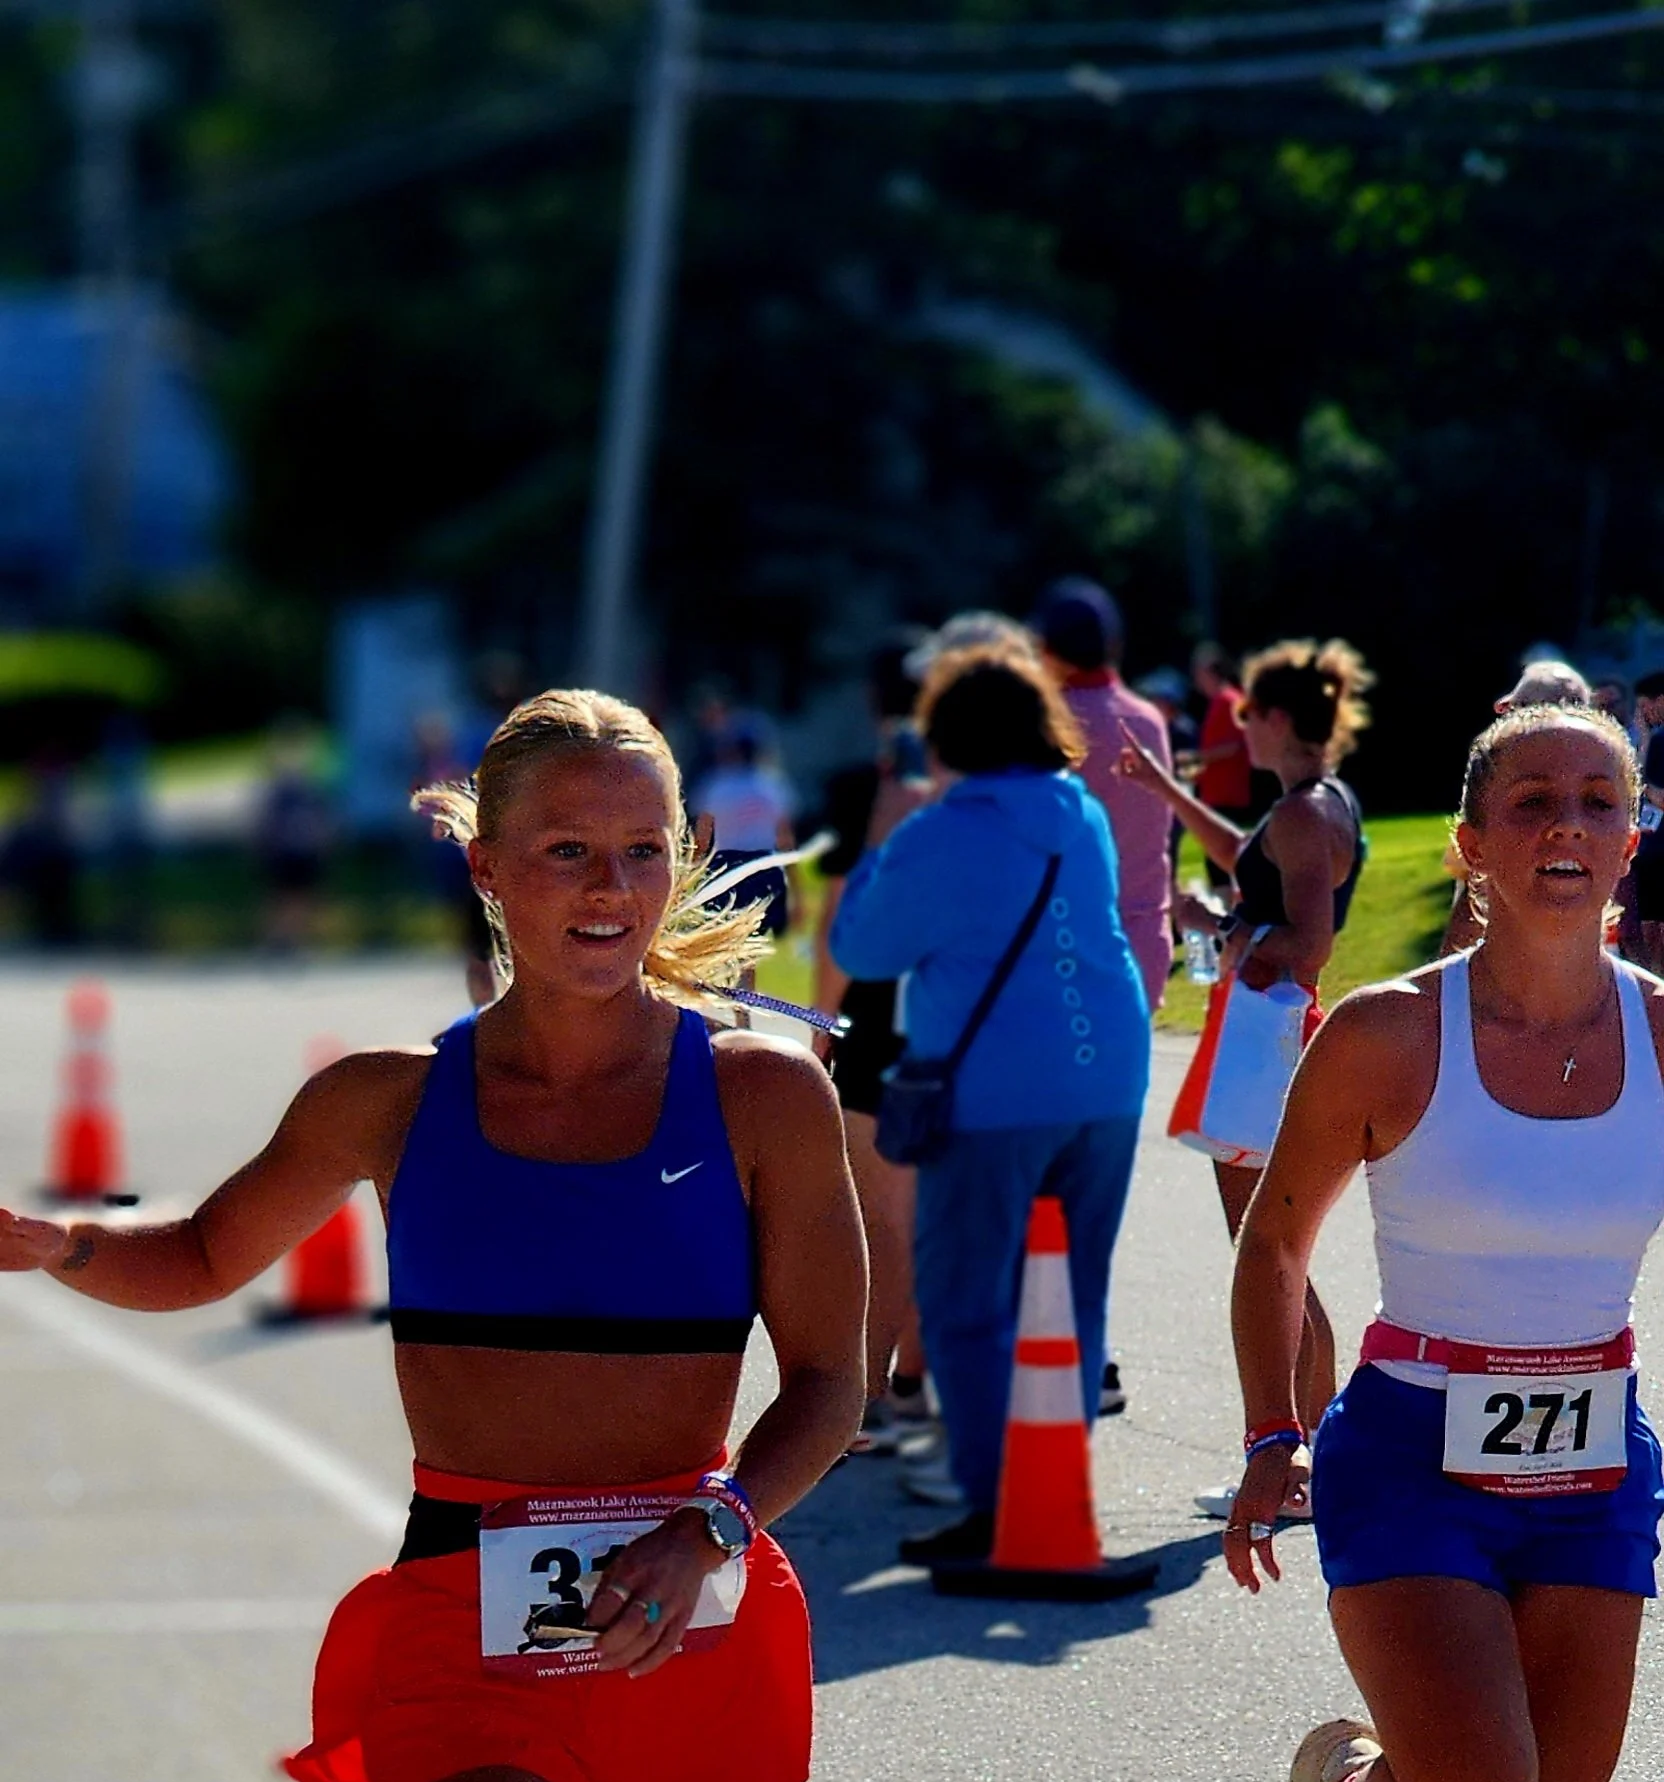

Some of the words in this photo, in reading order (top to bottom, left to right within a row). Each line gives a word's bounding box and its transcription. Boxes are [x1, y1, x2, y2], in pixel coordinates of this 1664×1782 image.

[1481, 1389, 1592, 1455] 271
[527, 1496, 599, 1511] Maranacook
[600, 1495, 627, 1508] Lake
